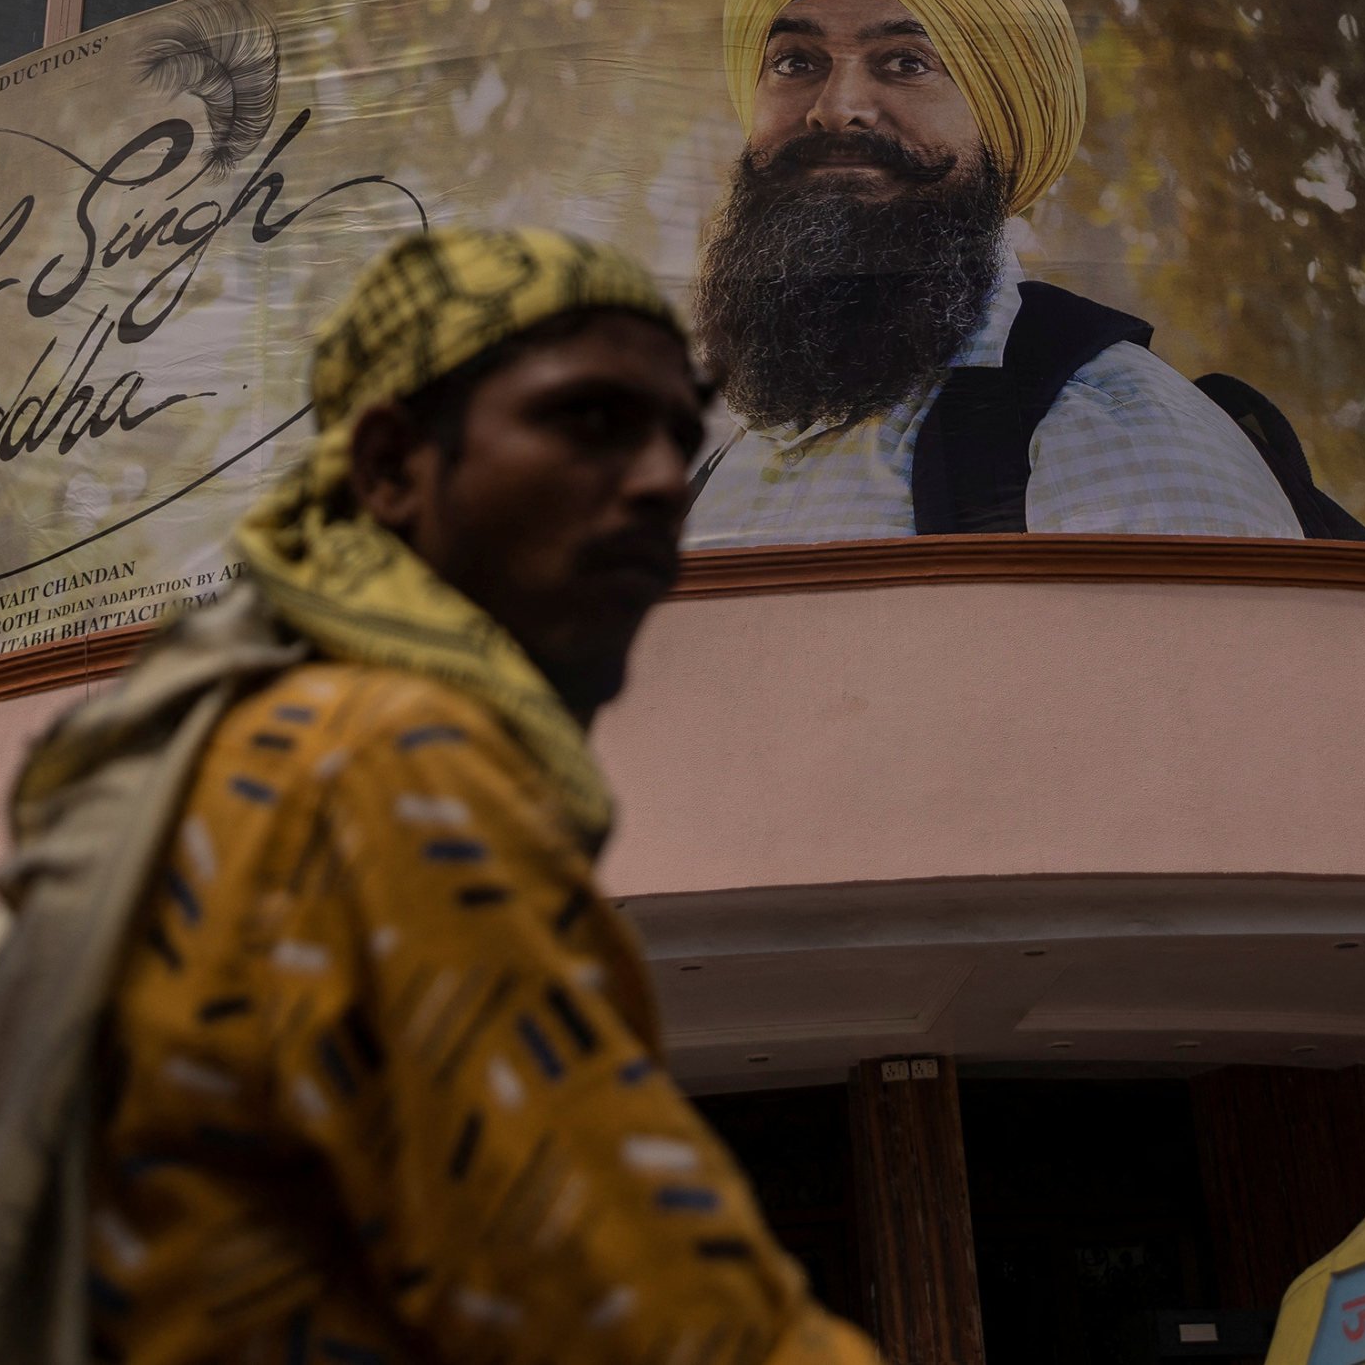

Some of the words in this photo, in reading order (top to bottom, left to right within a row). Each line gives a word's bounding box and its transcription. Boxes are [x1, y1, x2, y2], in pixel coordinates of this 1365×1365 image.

[26, 108, 313, 344] Singh
[43, 560, 137, 598] CHANDAN
[47, 597, 96, 620] INDIAN
[99, 576, 193, 608] ADAPTATION
[196, 571, 216, 587] BY
